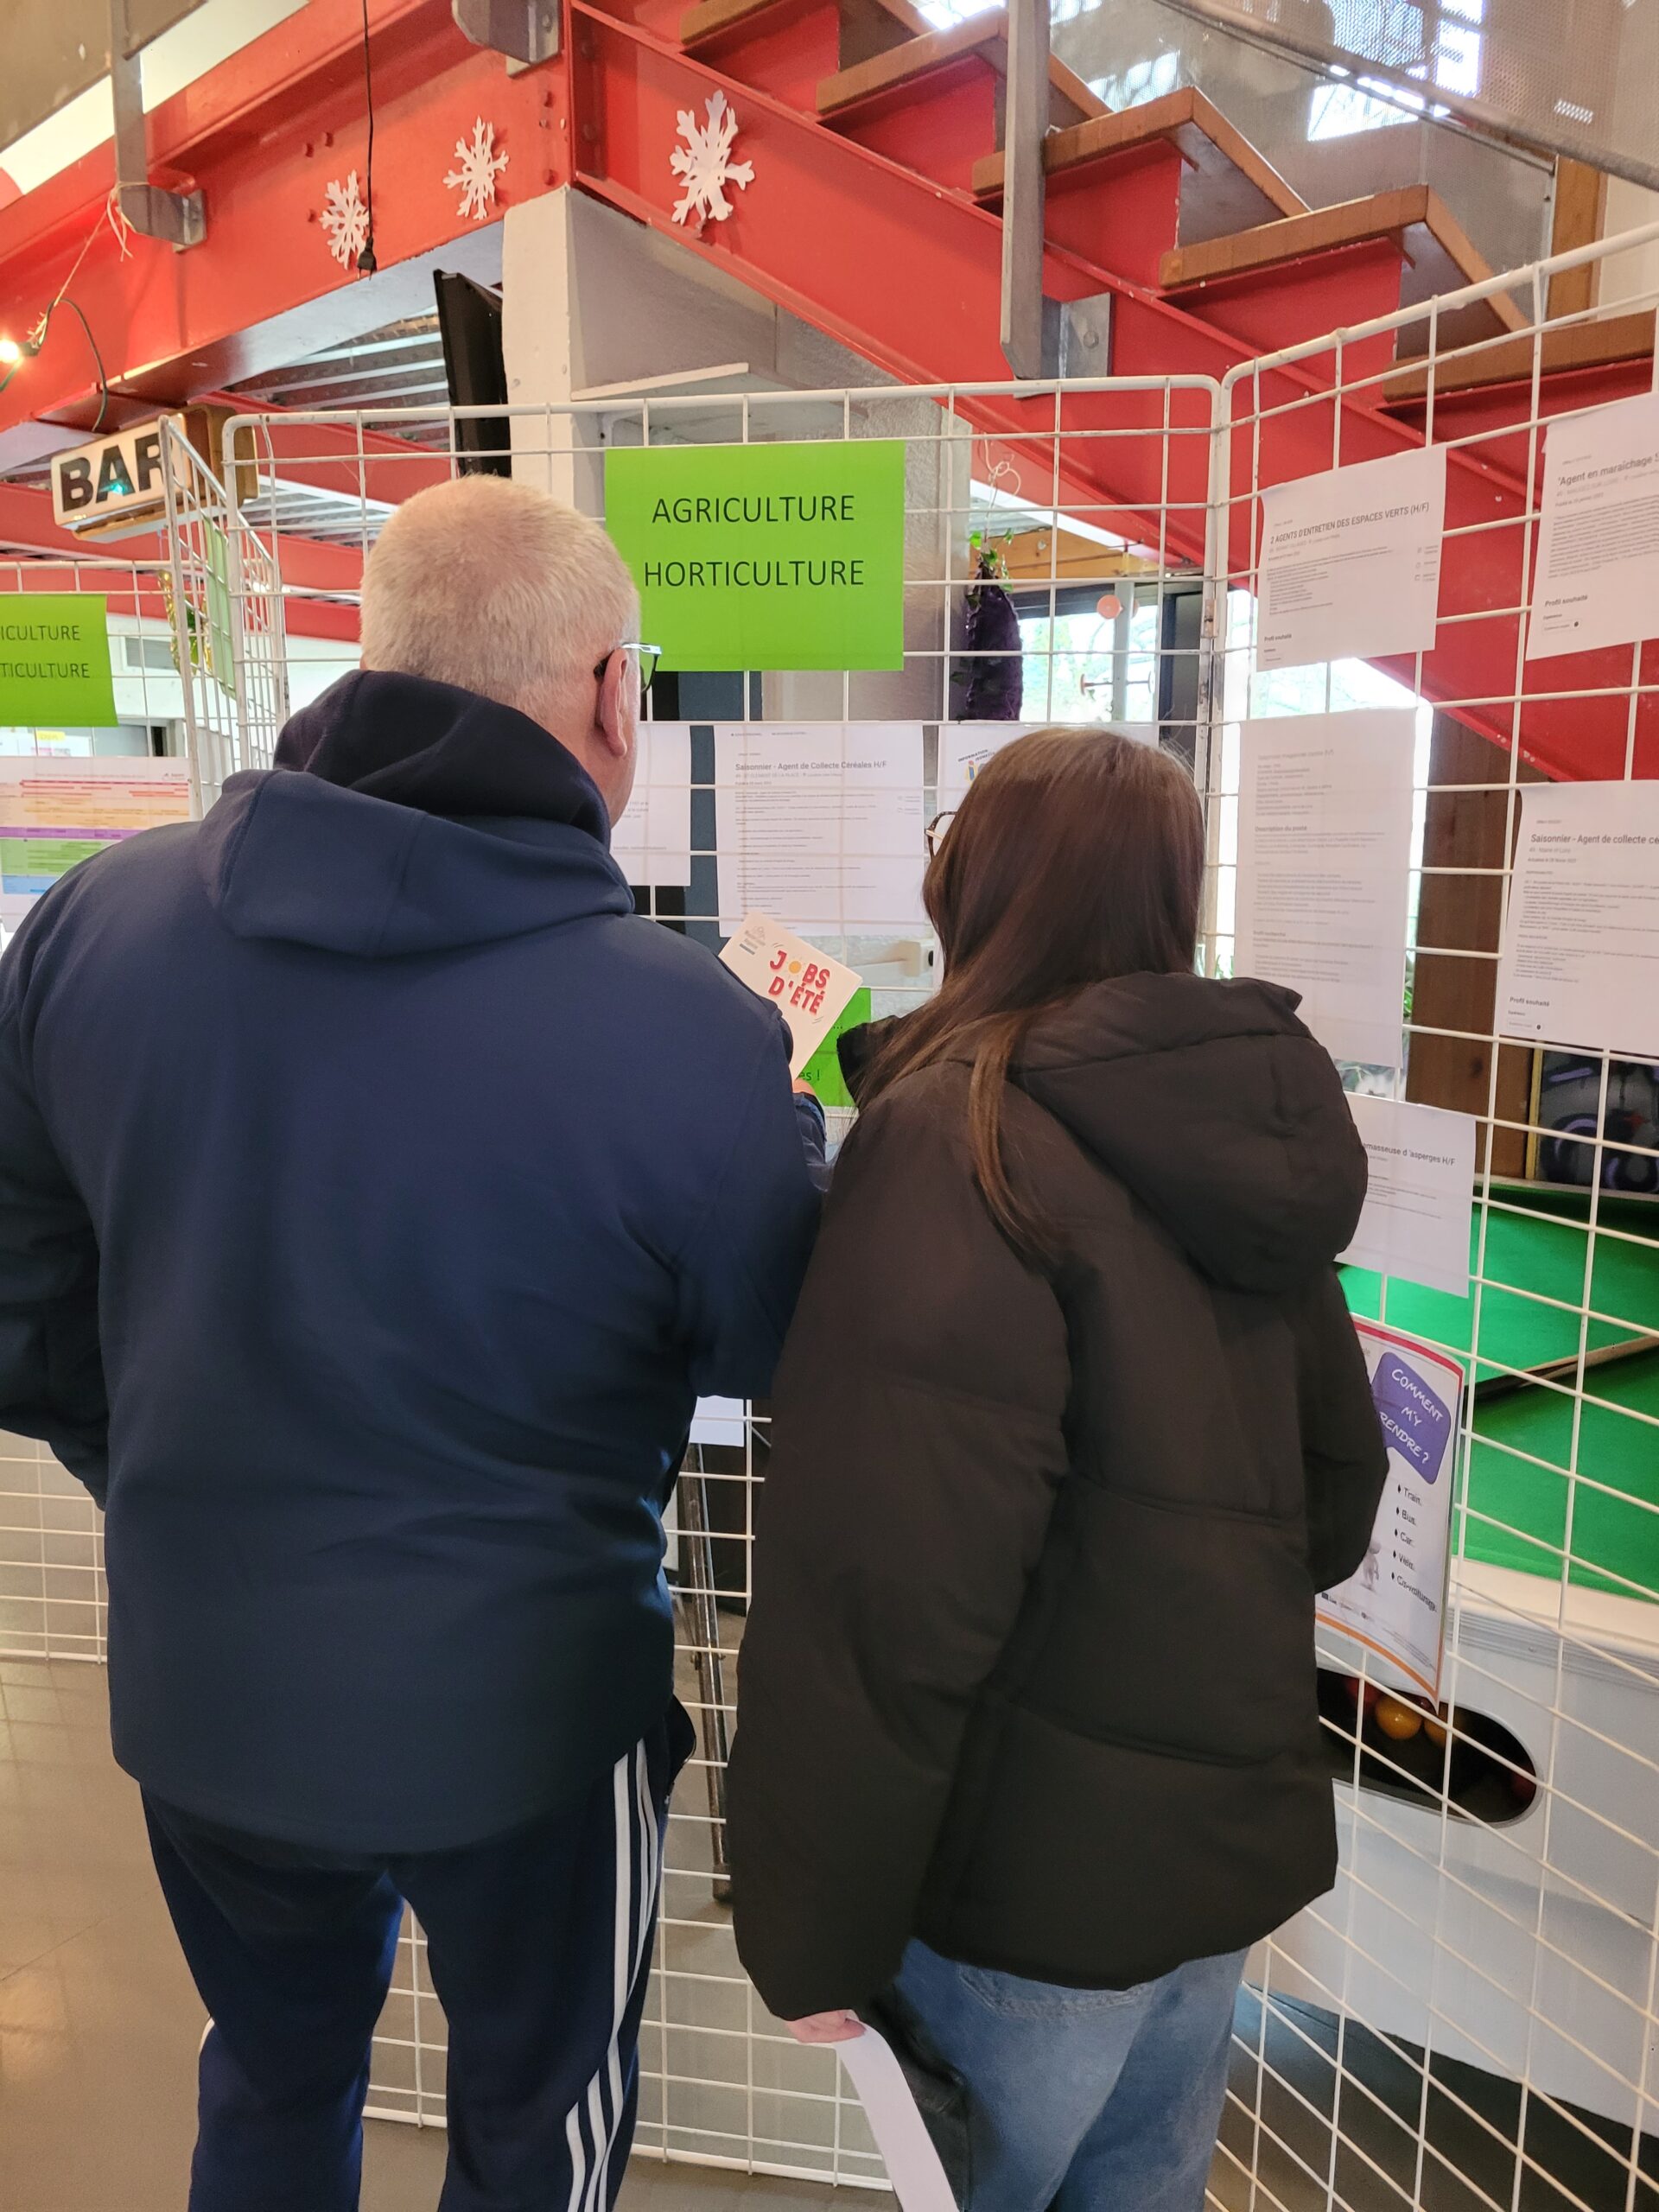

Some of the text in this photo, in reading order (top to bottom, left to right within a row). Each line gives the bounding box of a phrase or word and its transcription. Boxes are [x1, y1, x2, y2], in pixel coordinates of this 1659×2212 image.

[60, 432, 175, 512] BAR
[1587, 469, 1599, 480] en
[652, 495, 855, 524] AGRICULTURE
[1270, 536, 1274, 545] 2
[1275, 531, 1298, 543] AGENTS
[1299, 523, 1336, 537] D'ENTRETIEN
[1337, 519, 1350, 528] DES
[1351, 512, 1383, 525] ESPACES
[1384, 505, 1409, 518] VERTS
[1410, 502, 1430, 515] (H/F)
[645, 560, 864, 587] HORTICULTURE
[0, 625, 81, 641] ICULTURE
[0, 662, 91, 678] TICULTURE
[735, 763, 772, 772] Saisonnier
[778, 762, 799, 772] Agent
[801, 761, 810, 770] de
[810, 761, 840, 770] Collecte
[1531, 834, 1571, 843] Saisonnier
[1578, 835, 1599, 845] Agent
[1602, 834, 1611, 843] de
[1613, 835, 1646, 844] collecte
[1442, 1157, 1455, 1166] H/F
[1391, 1368, 1444, 1422] COMMENT
[1402, 1406, 1422, 1427] M'Y
[1379, 1411, 1429, 1464] RENDRE ?
